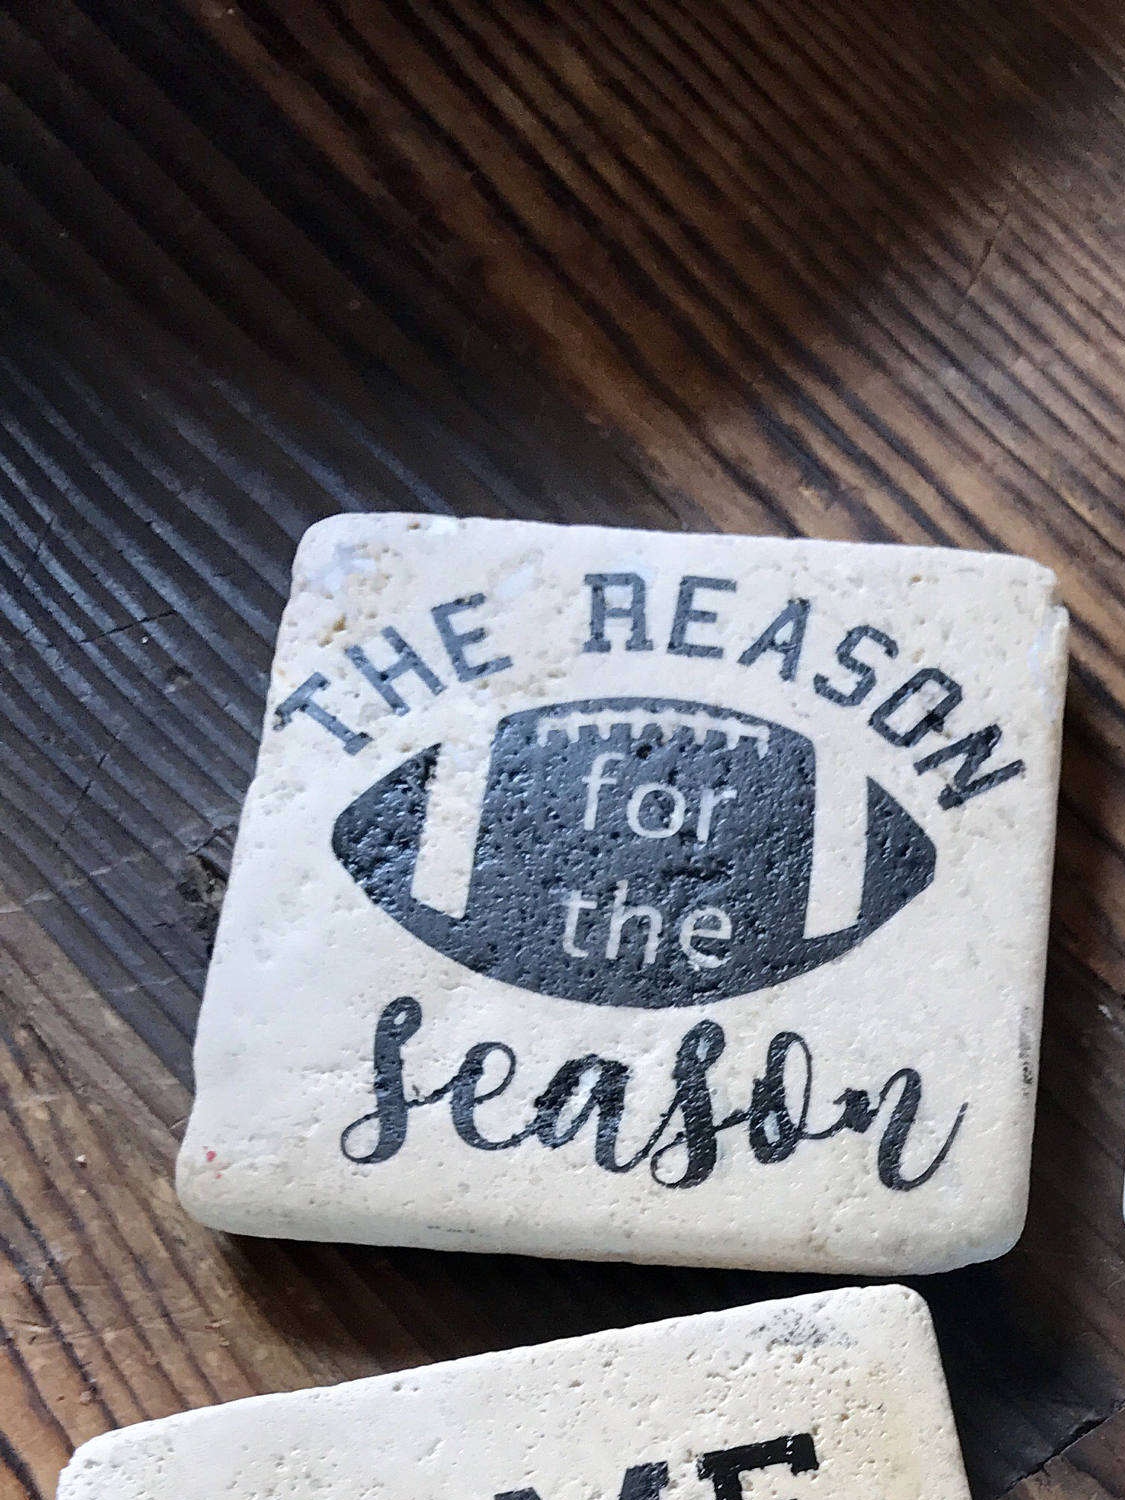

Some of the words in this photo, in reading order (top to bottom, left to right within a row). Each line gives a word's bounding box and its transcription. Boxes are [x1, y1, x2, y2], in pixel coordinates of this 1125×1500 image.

[275, 593, 512, 756] THE
[583, 572, 1028, 811] REASON
[582, 751, 738, 843] for
[562, 879, 735, 972] the
